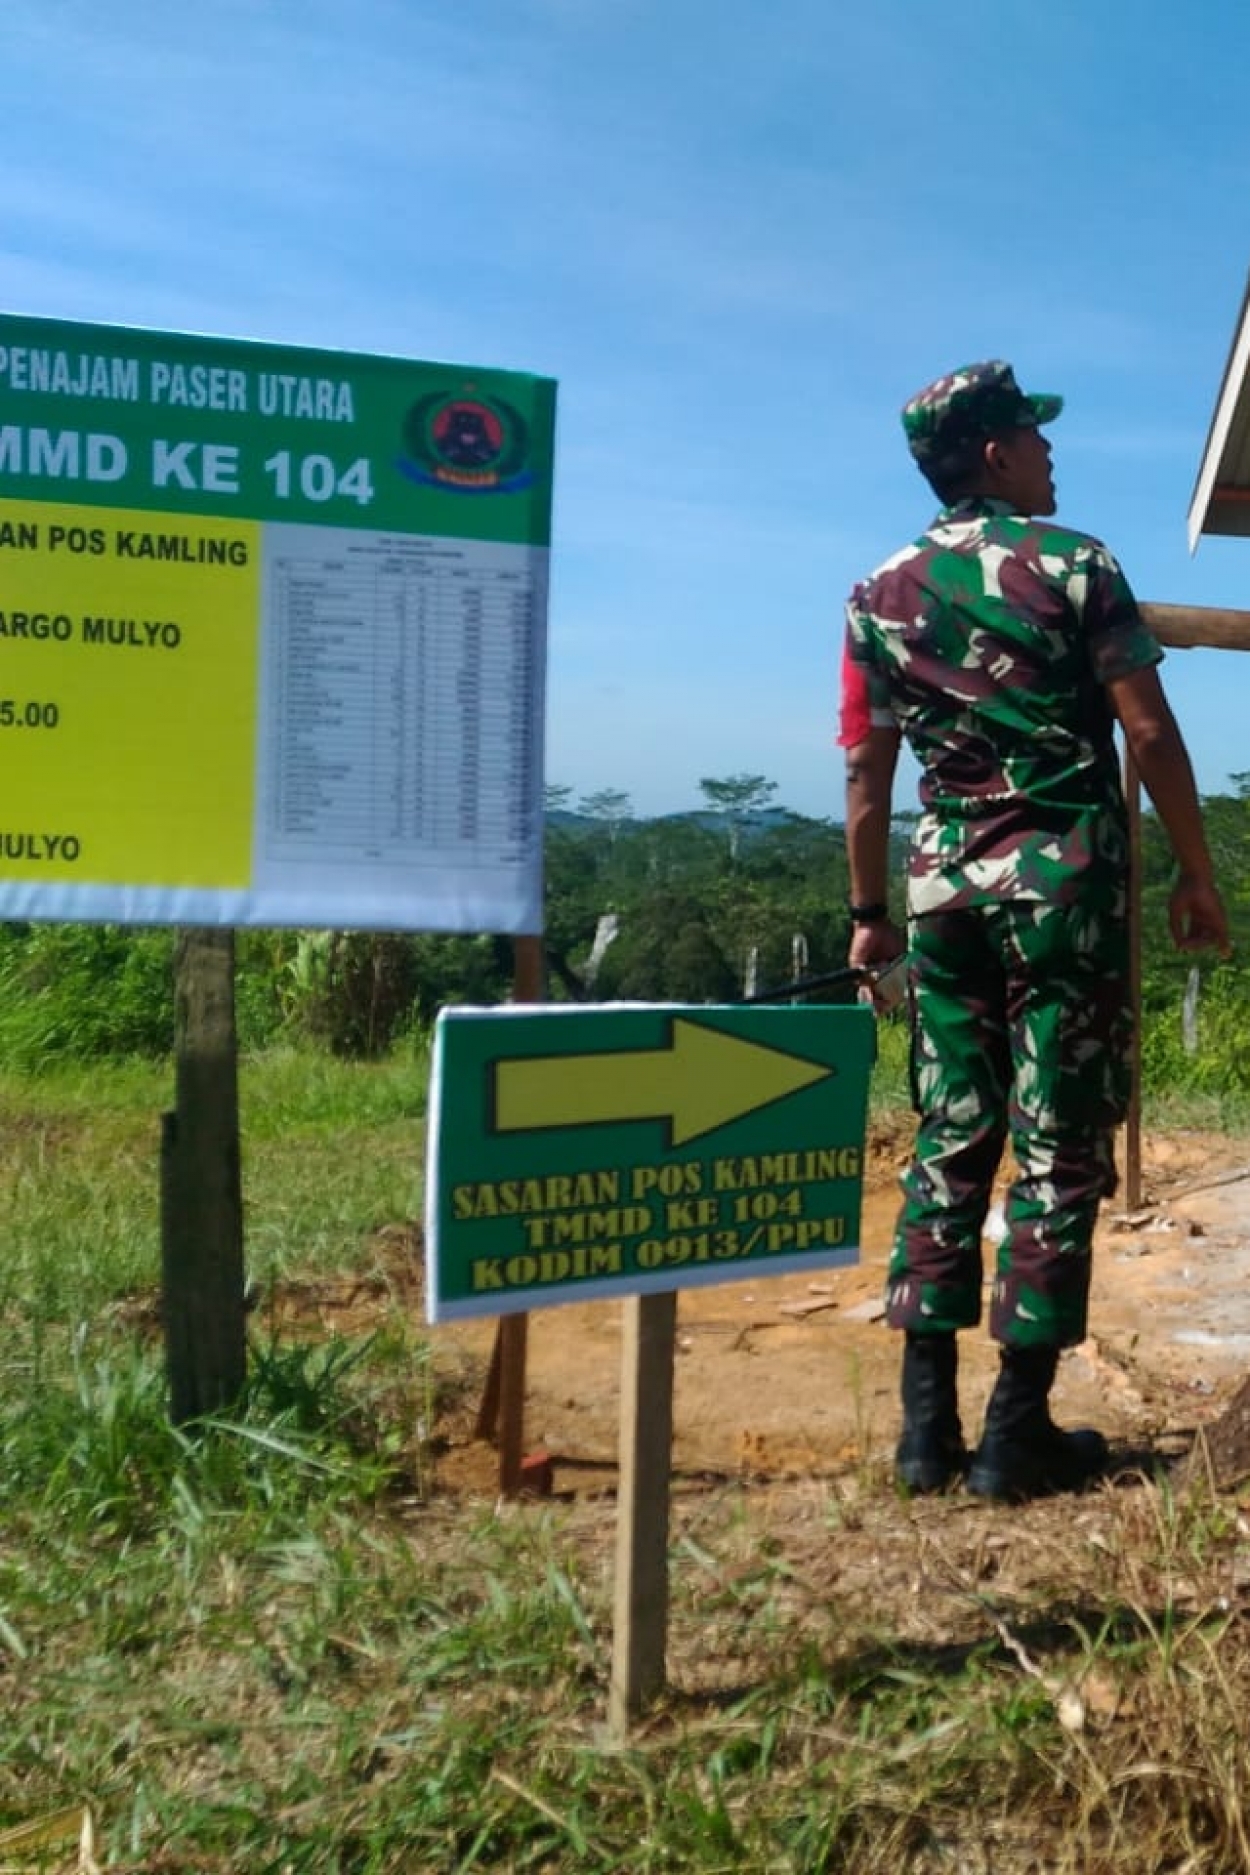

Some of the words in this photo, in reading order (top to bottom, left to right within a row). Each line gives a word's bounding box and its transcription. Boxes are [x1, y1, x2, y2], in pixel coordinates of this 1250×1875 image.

[151, 361, 248, 413] PASER
[258, 372, 355, 423] UTARA
[153, 439, 240, 494] KE
[264, 449, 375, 506] 104
[49, 525, 106, 555] POS
[116, 530, 248, 567] KAMLING
[83, 616, 181, 649] MULYO
[0, 833, 81, 862] ULYO
[453, 1169, 619, 1221] SASARAN
[632, 1160, 702, 1201] POS
[714, 1147, 860, 1192] KAMLING
[523, 1206, 652, 1248] TMMD
[666, 1197, 720, 1233] KE
[734, 1188, 802, 1224] 104
[472, 1242, 622, 1293] KODIM
[636, 1216, 846, 1270] 0913/PPU
